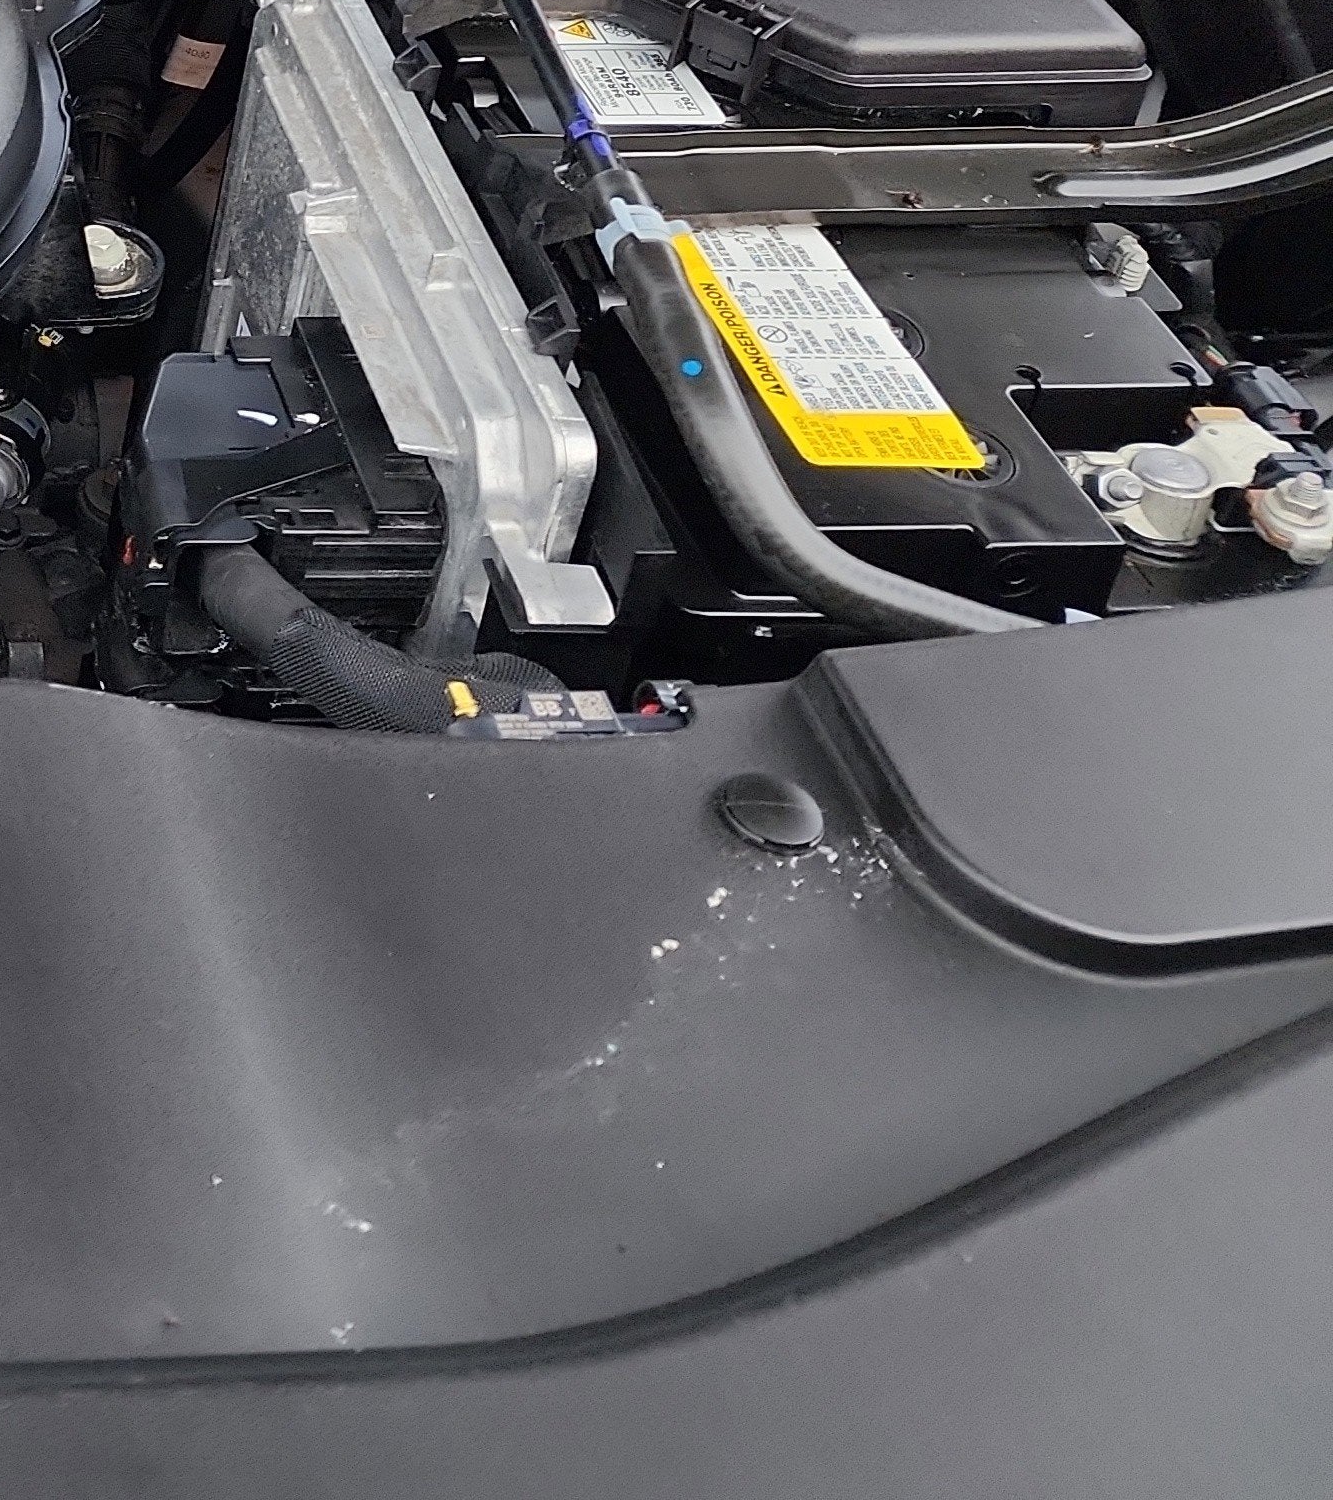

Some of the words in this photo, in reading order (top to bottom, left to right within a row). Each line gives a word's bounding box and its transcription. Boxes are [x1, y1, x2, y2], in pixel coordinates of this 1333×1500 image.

[612, 68, 641, 96] 8540
[665, 73, 683, 91] 80Ah
[681, 97, 697, 111] 730
[699, 282, 777, 382] DANGER/POISON
